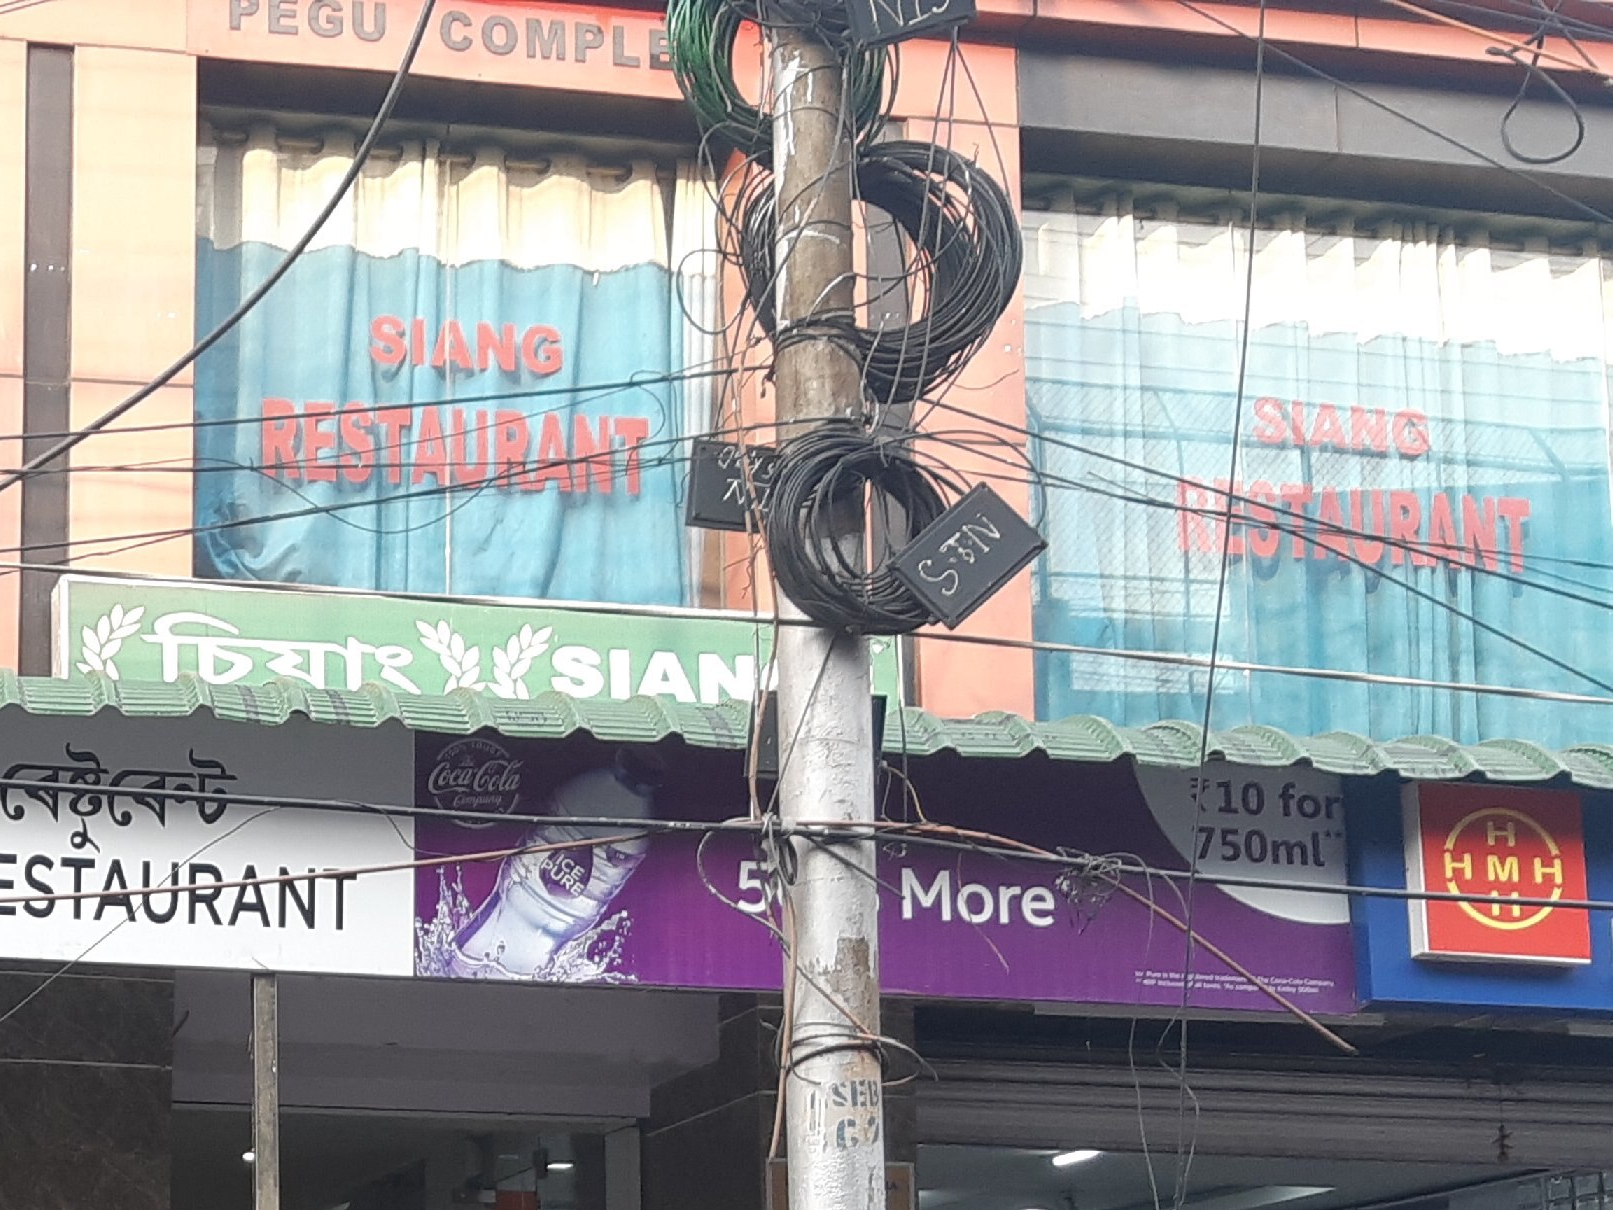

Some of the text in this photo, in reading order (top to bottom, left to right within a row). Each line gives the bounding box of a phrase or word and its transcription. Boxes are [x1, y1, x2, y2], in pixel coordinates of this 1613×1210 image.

[228, 0, 672, 70] PEGU COMPLE
[369, 316, 562, 375] SIANG
[261, 398, 649, 494] RESTAURANT
[1253, 396, 1429, 456] SIANG
[1177, 476, 1529, 573] RESTAURANT
[551, 645, 778, 704] SIAN
[1279, 781, 1343, 819] for
